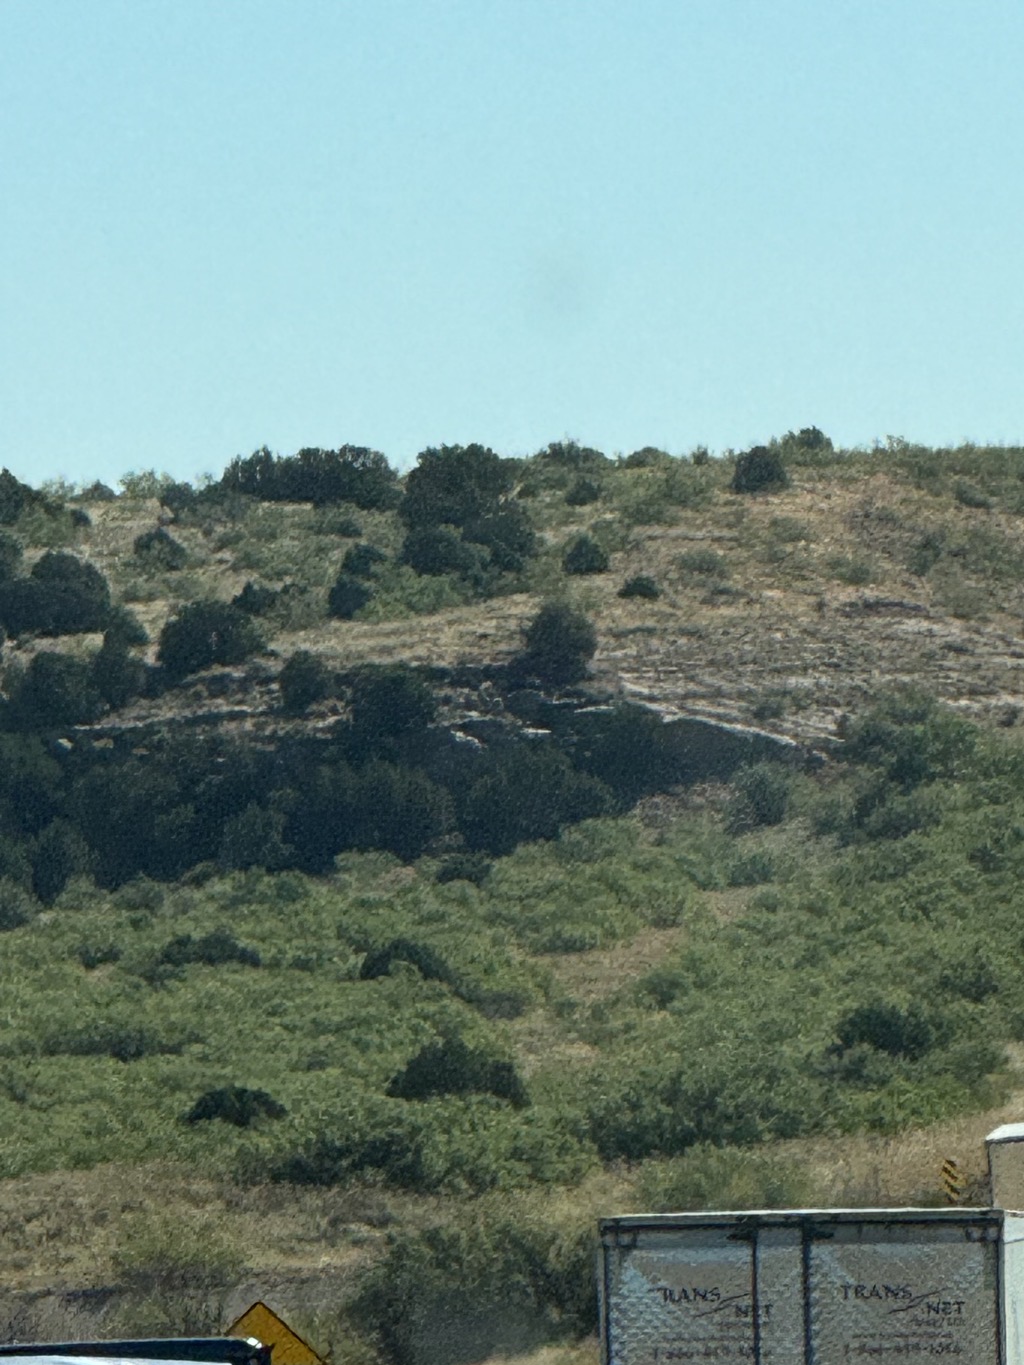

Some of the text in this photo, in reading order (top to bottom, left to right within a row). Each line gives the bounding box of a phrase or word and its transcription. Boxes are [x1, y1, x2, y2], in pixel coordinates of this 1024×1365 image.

[841, 1284, 912, 1300] TRANS
[735, 1304, 773, 1318] NT
[926, 1300, 965, 1315] NET
